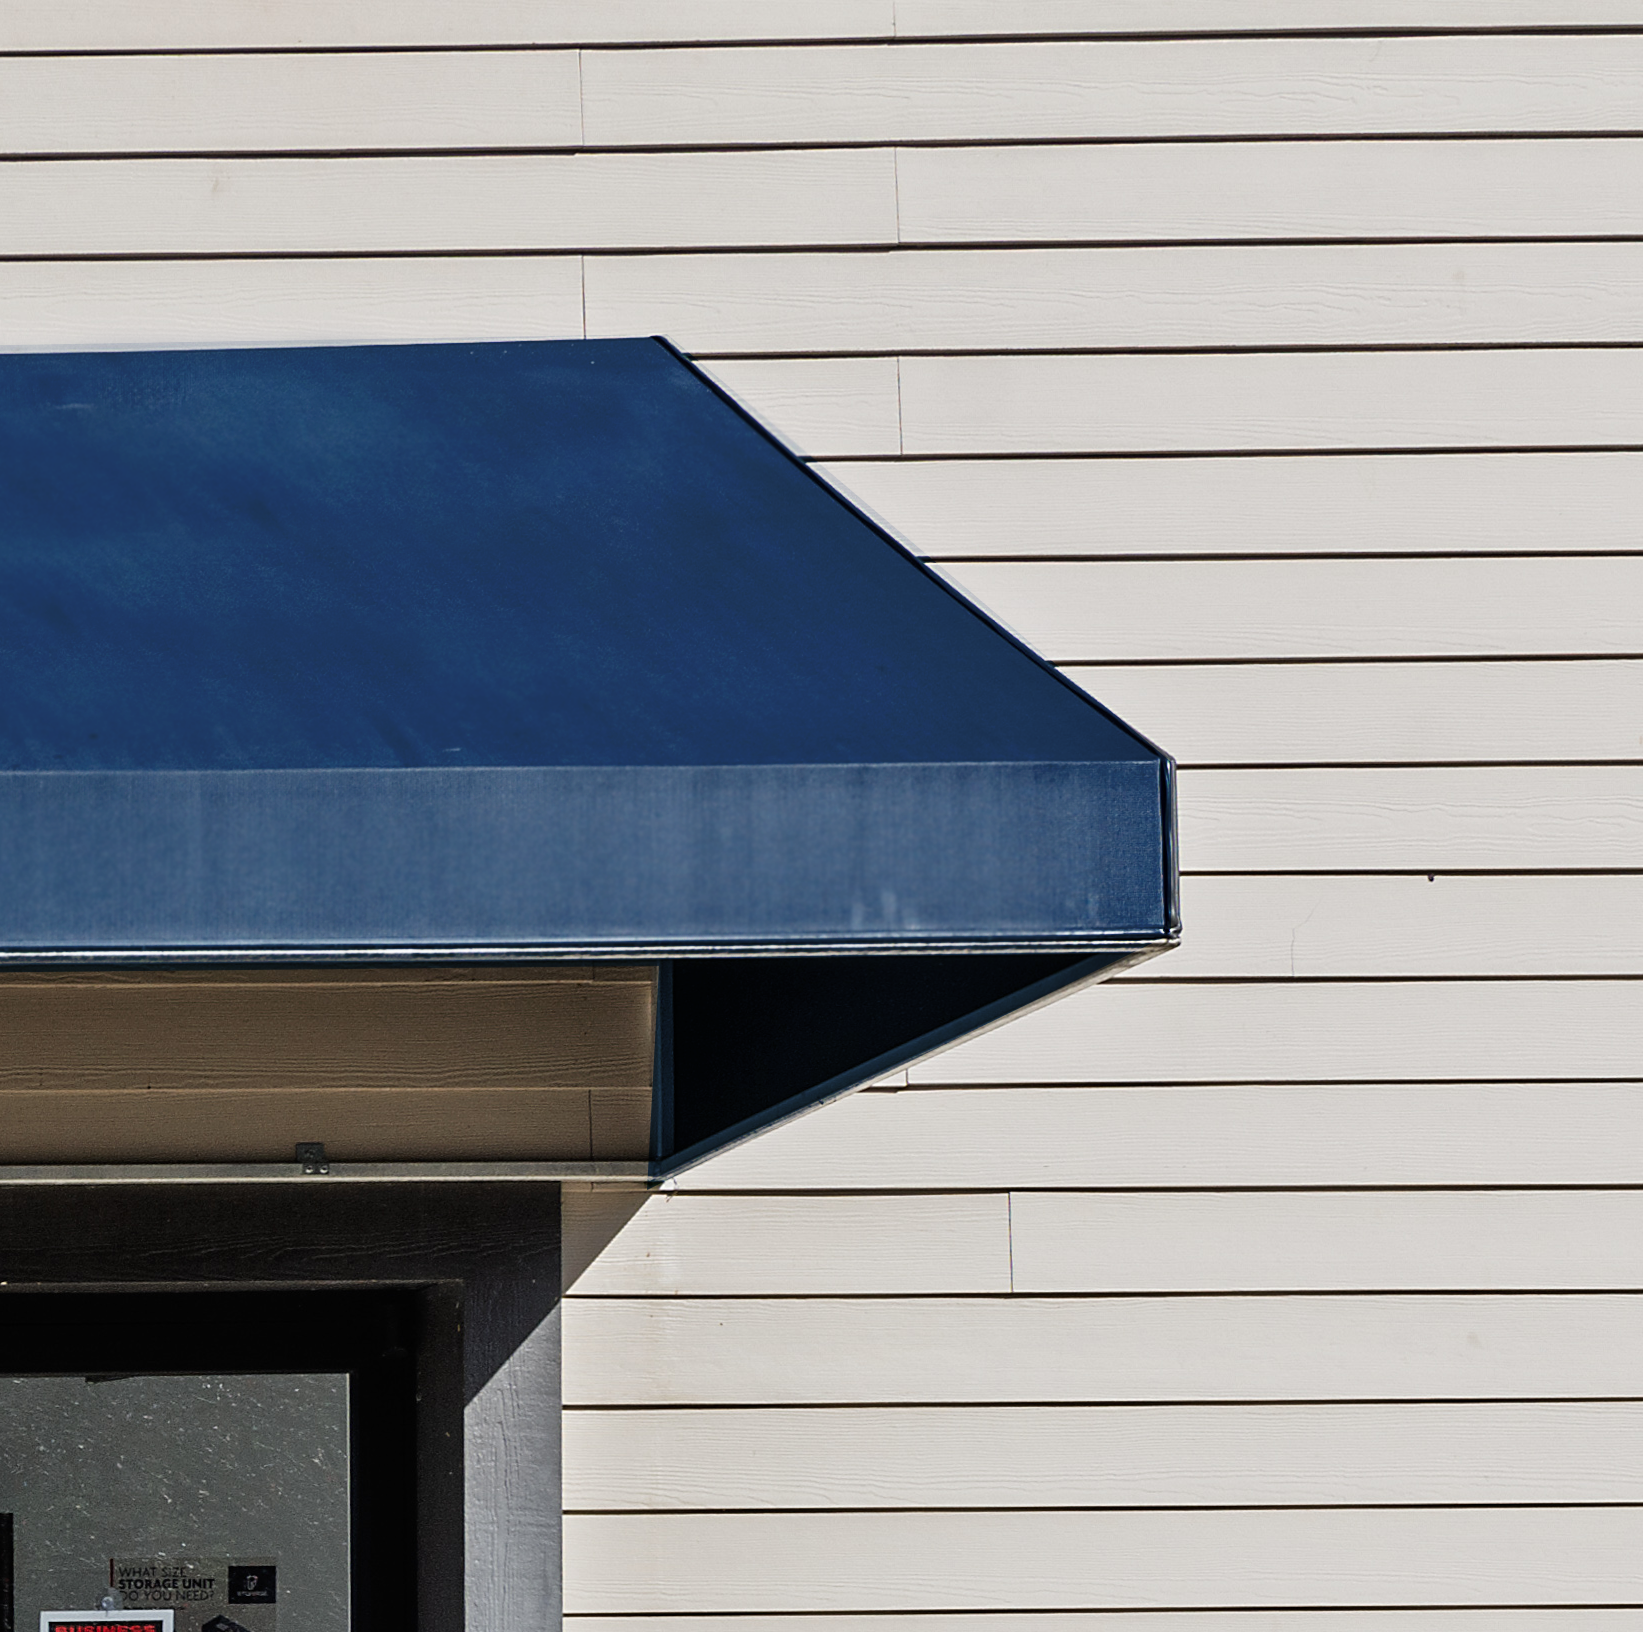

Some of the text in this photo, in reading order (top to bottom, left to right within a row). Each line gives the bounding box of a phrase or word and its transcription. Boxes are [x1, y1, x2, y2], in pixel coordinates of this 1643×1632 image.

[118, 1567, 187, 1577] WHAT SIZE
[118, 1579, 215, 1590] STORAGE UNIT
[144, 1590, 172, 1601] YOU
[176, 1590, 215, 1600] NEED?
